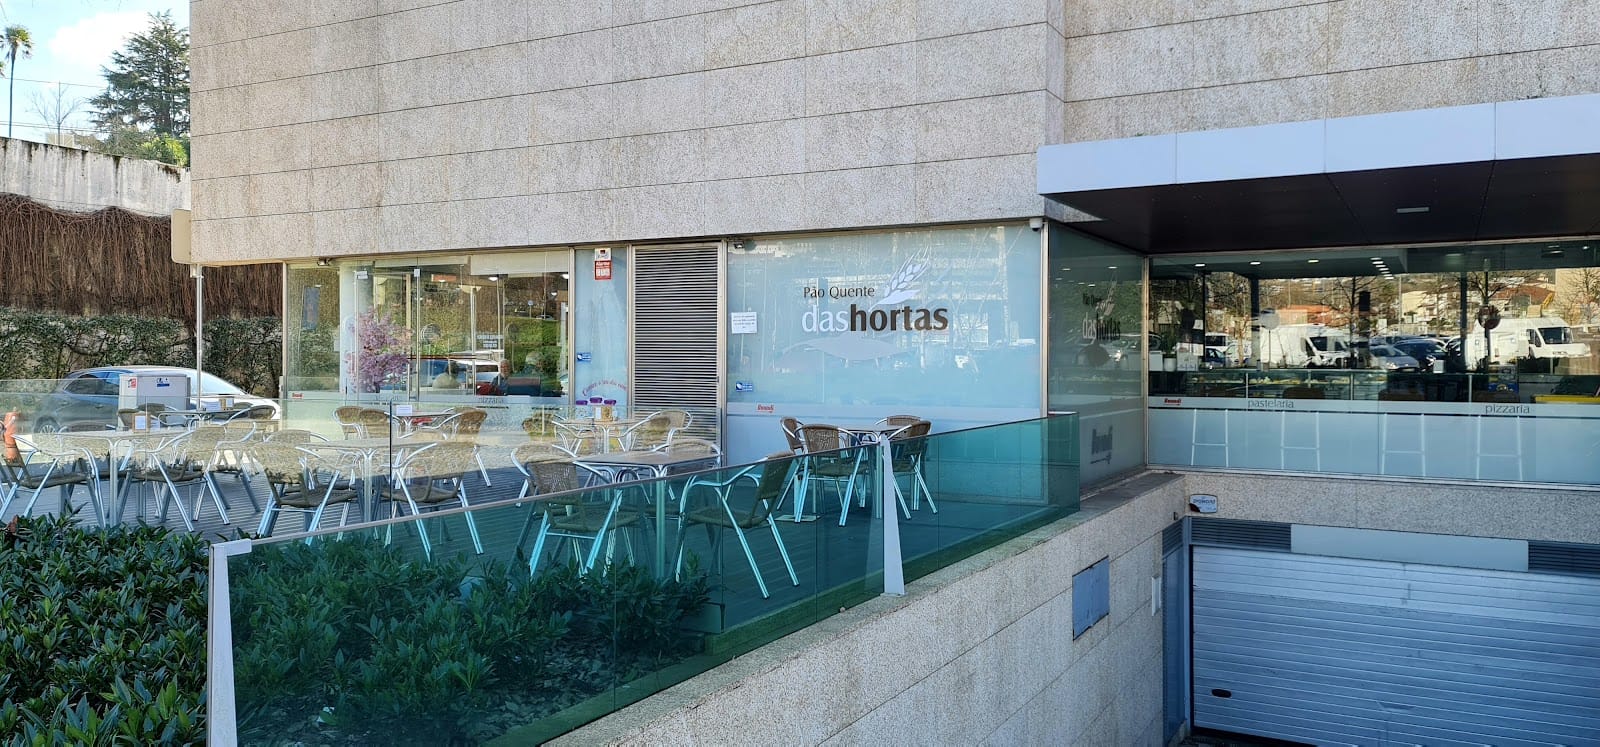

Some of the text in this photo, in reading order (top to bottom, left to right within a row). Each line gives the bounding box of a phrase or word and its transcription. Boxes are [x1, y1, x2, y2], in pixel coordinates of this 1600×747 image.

[804, 286, 875, 299] Pão Quente
[1247, 398, 1294, 410] pastelaria
[1485, 403, 1530, 415] pizzaria
